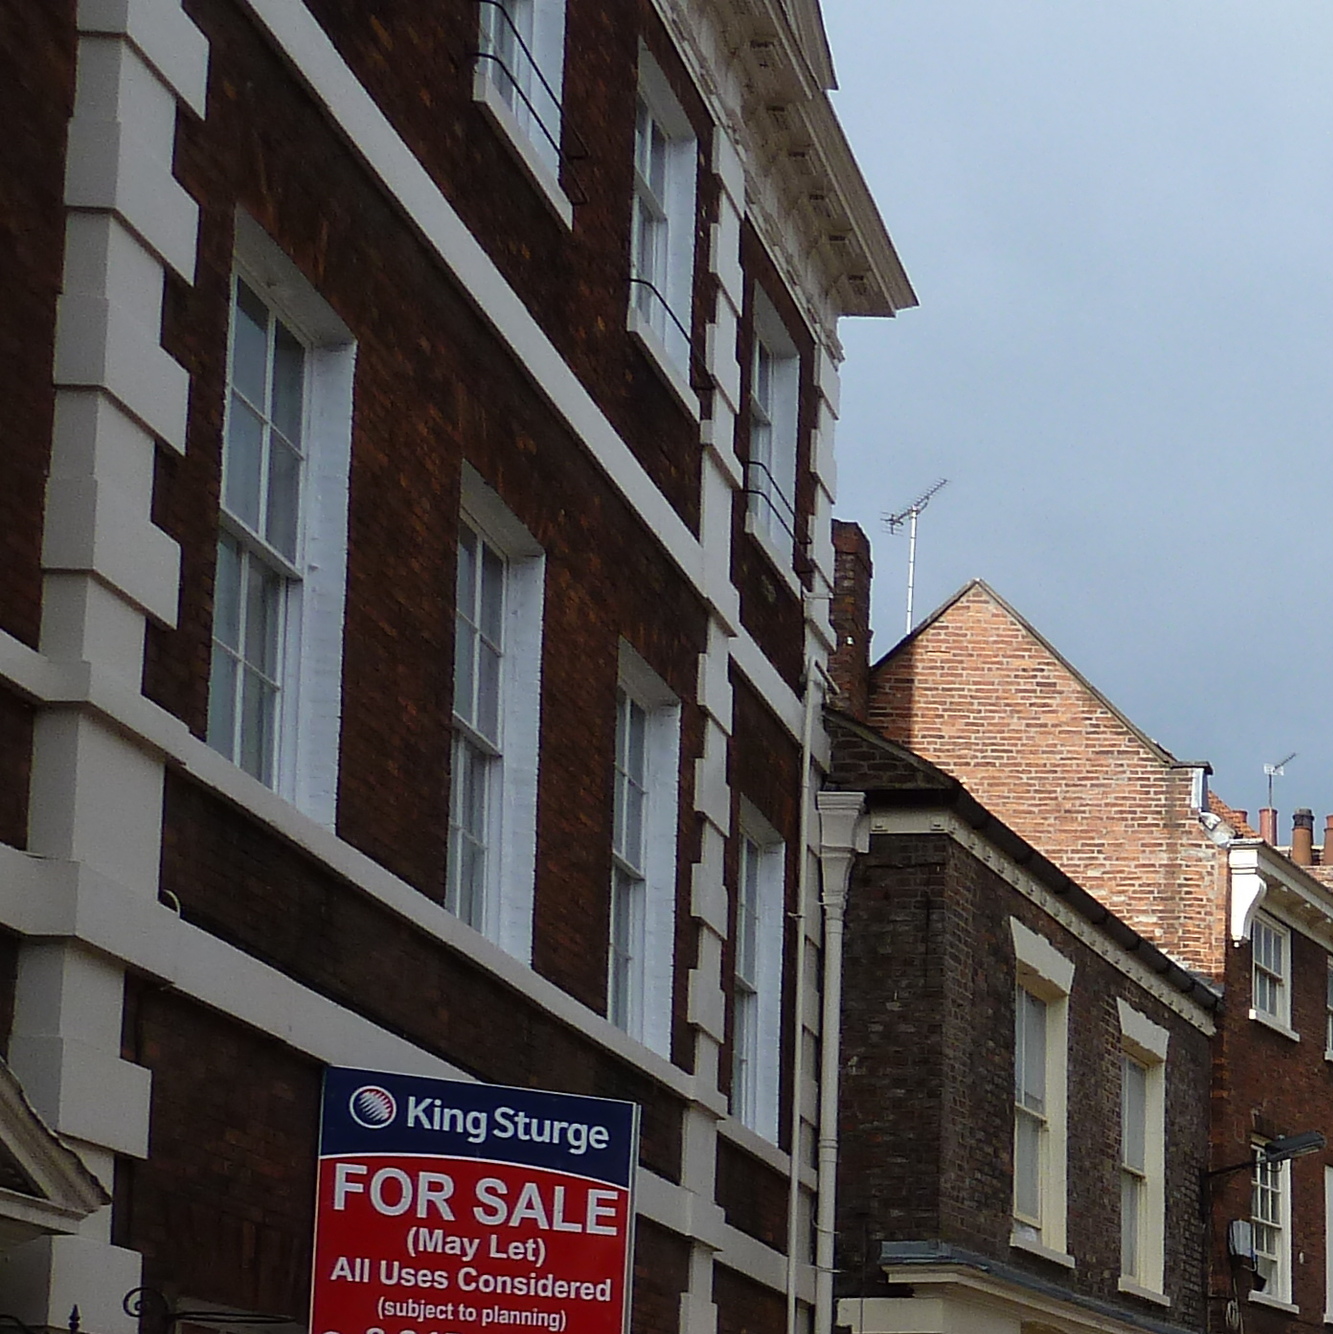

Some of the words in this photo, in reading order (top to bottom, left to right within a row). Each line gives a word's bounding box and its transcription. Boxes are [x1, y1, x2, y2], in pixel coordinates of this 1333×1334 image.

[407, 1096, 487, 1143] King
[493, 1106, 609, 1155] Sturge
[333, 1163, 455, 1221] FOR
[473, 1177, 618, 1236] SALE
[406, 1227, 480, 1262] (May
[489, 1234, 546, 1267] Let)
[330, 1257, 370, 1283] All
[379, 1260, 448, 1289] Uses
[457, 1267, 611, 1301] Considered
[377, 1297, 453, 1322] (subject
[458, 1303, 476, 1321] to
[481, 1307, 566, 1331] planning)
